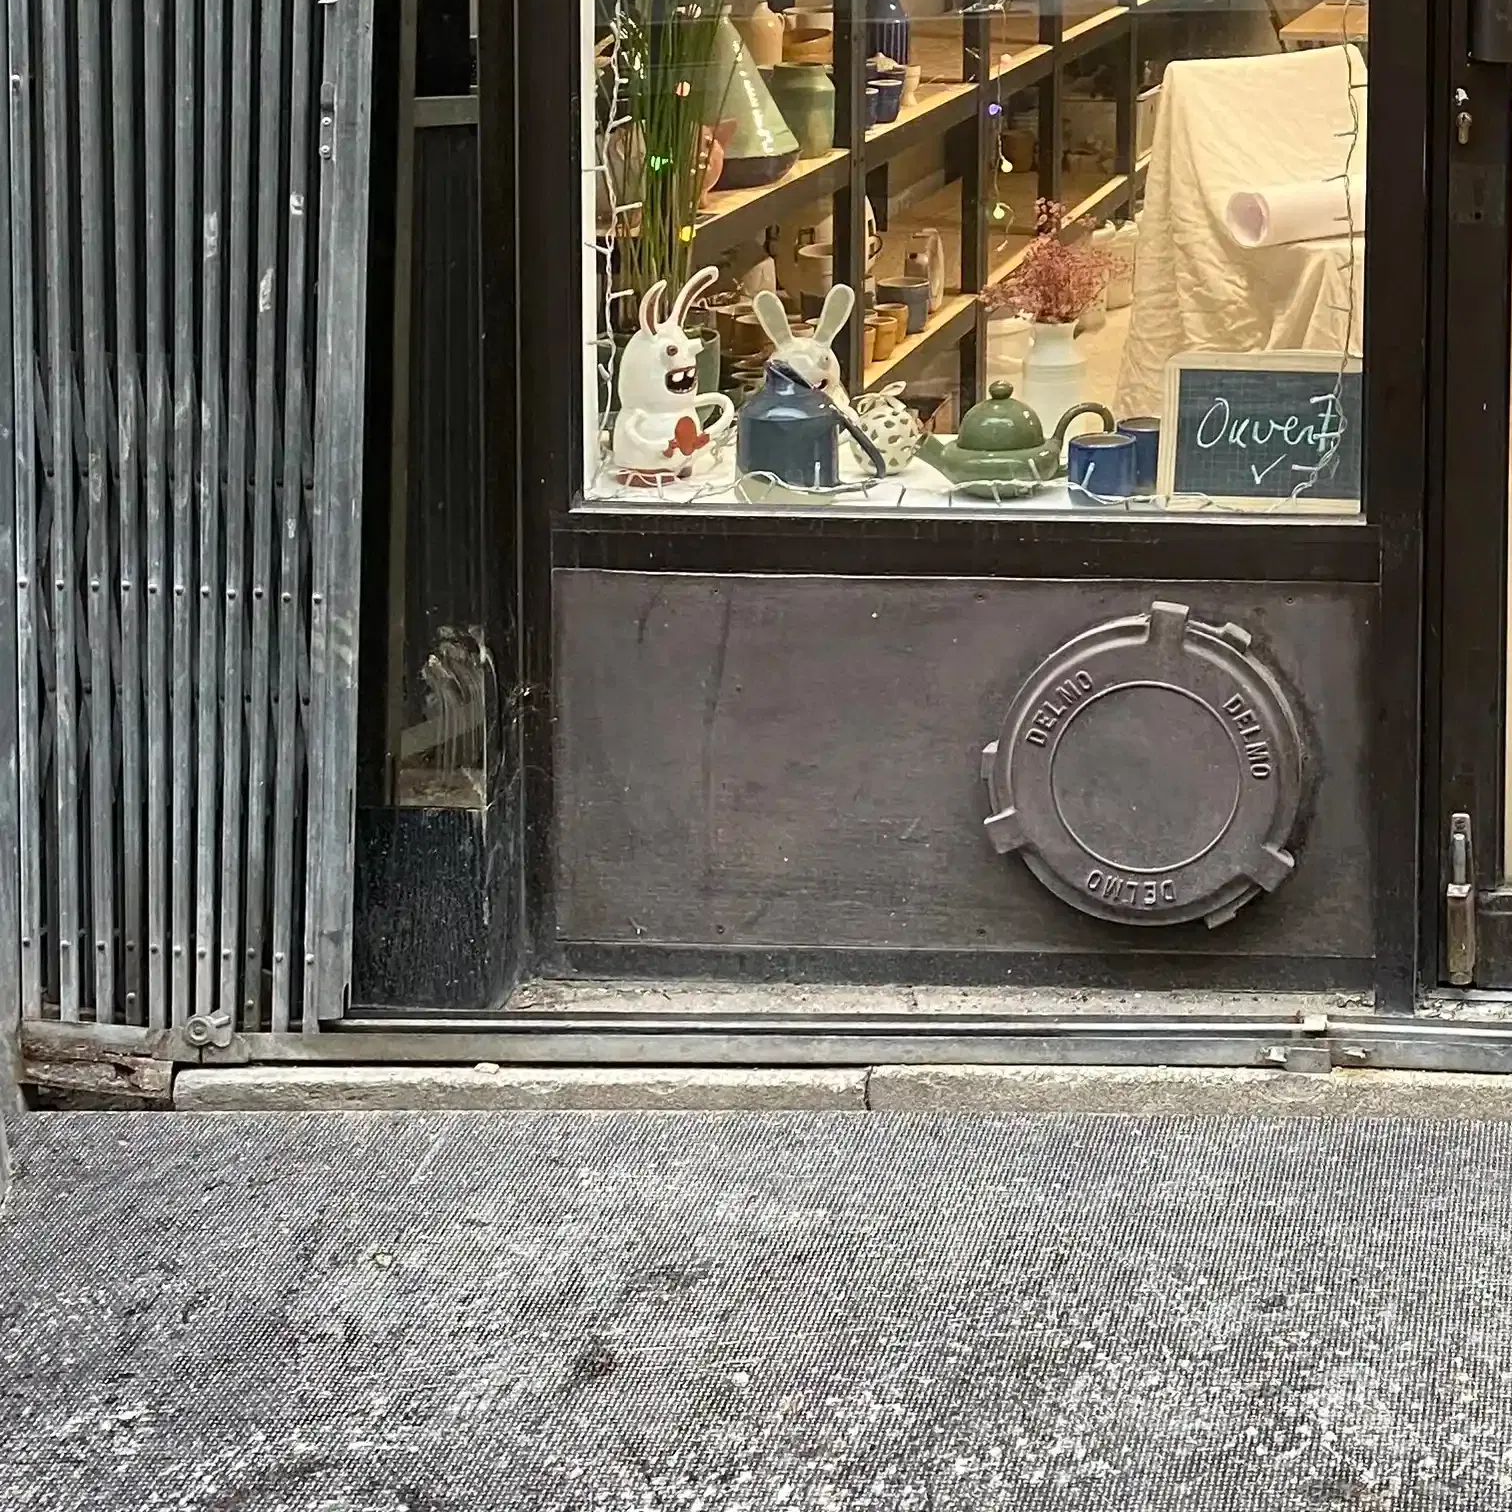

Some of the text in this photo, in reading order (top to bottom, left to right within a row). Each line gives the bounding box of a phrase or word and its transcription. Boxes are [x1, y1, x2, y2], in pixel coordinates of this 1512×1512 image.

[1197, 397, 1339, 452] Ouvert
[1024, 669, 1094, 748] DELMO
[1222, 691, 1272, 781] DELMO
[1087, 868, 1177, 905] DELMO
